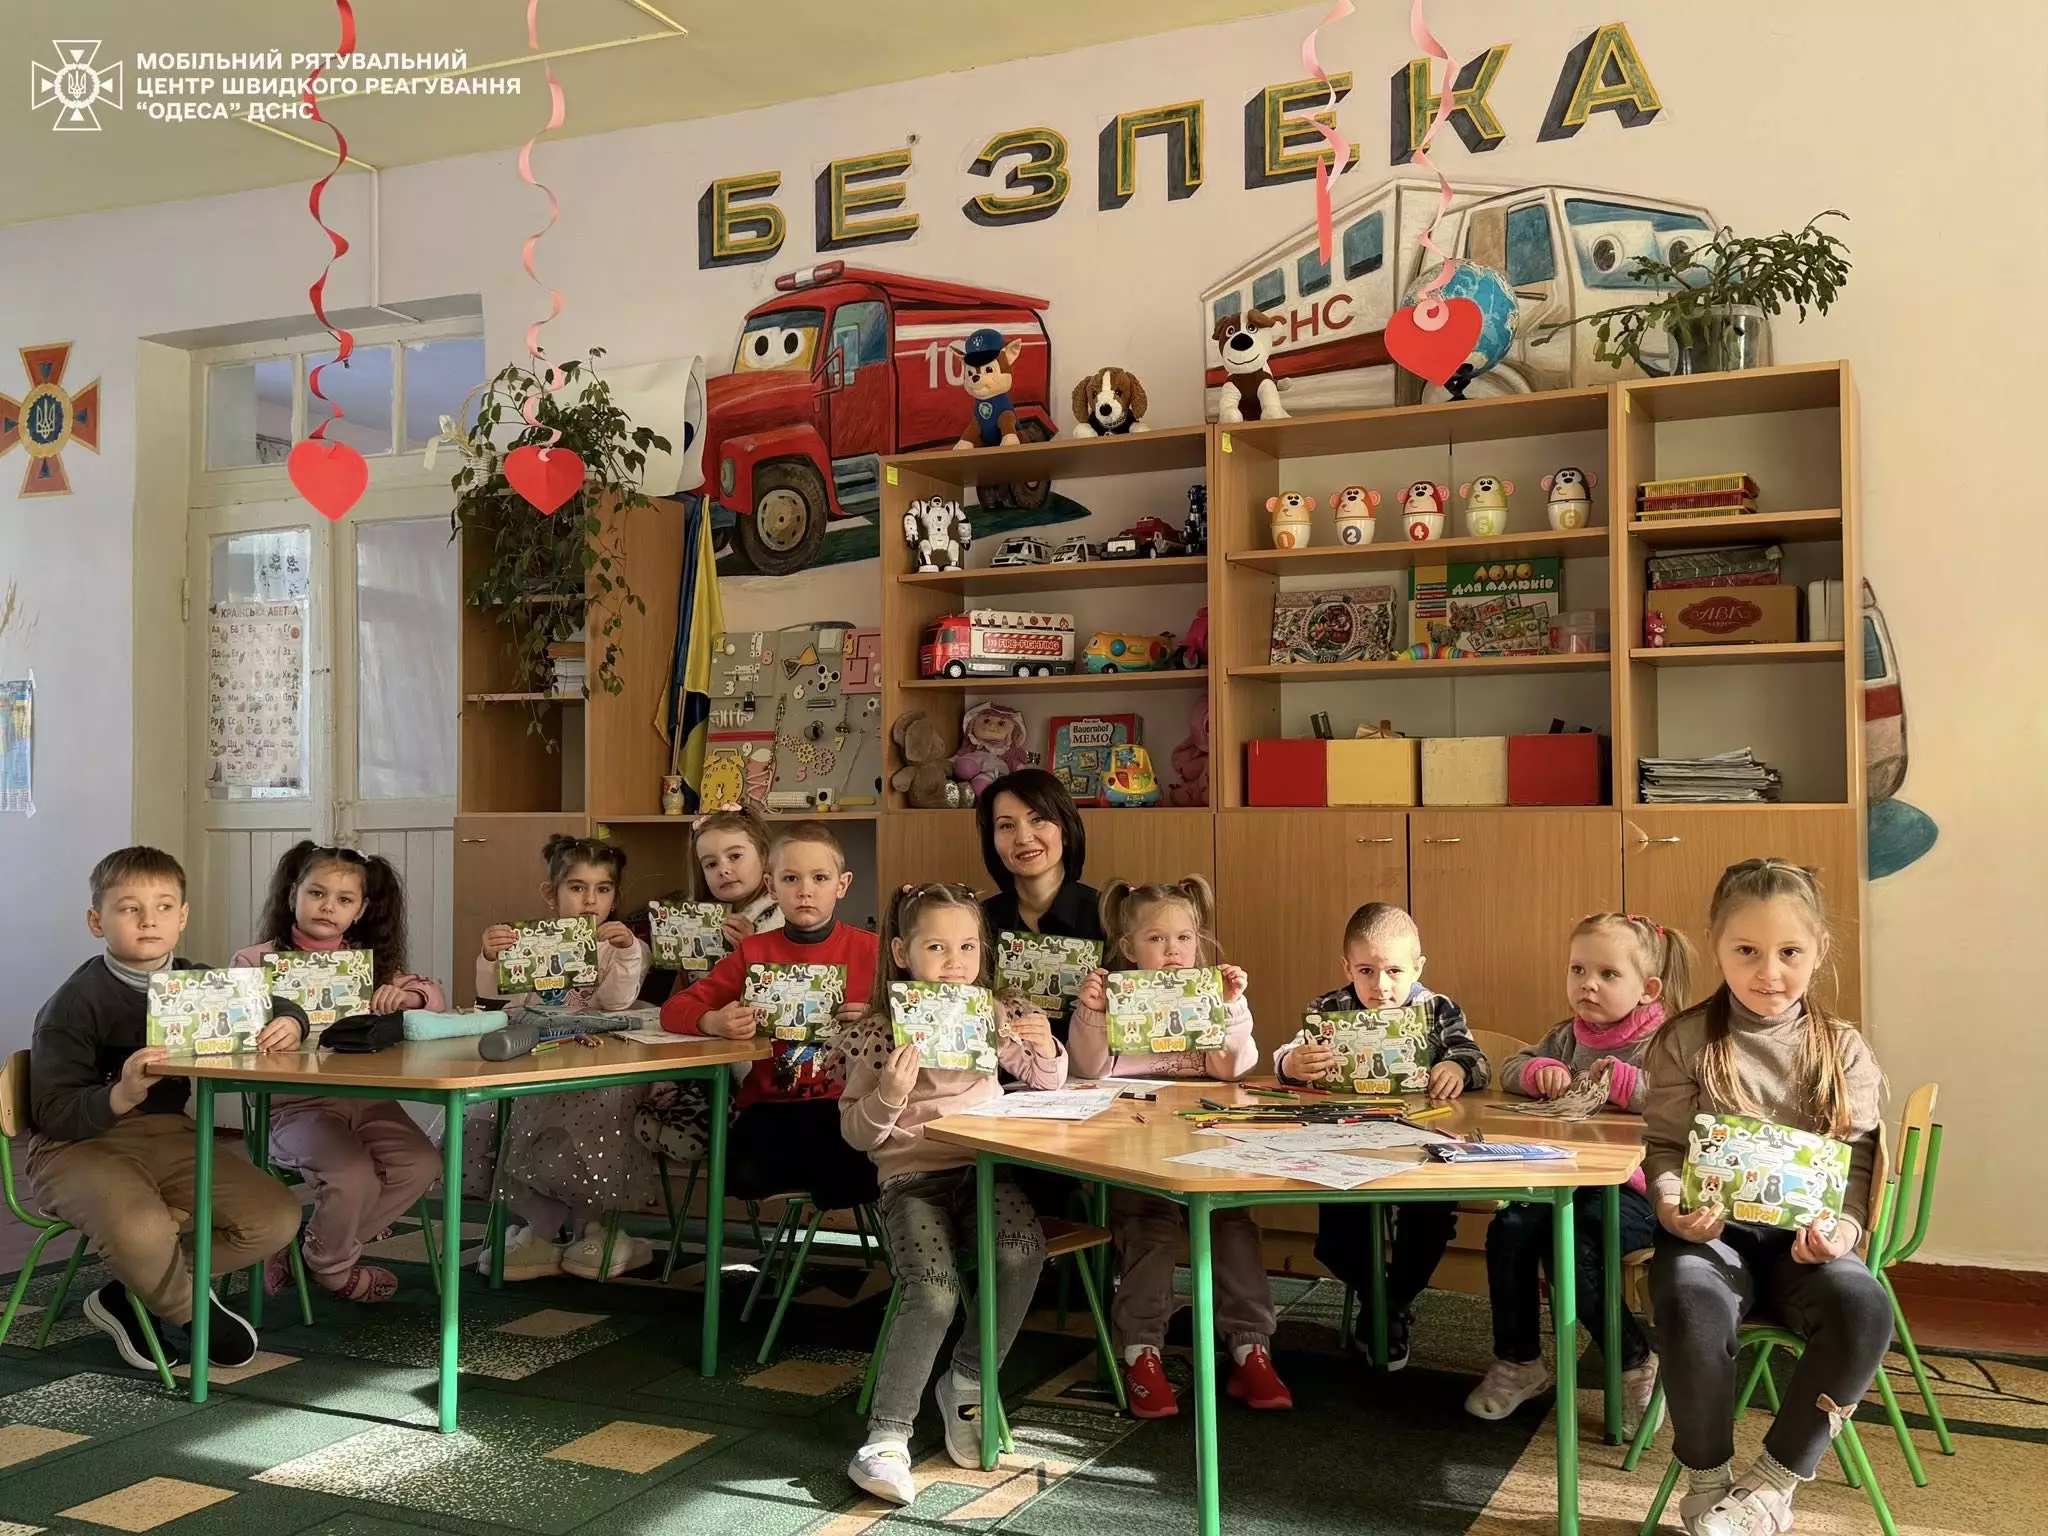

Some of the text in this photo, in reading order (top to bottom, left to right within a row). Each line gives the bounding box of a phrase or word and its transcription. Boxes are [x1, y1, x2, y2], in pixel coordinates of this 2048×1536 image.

[699, 22, 1663, 269] БЕЗПЕКА
[1473, 563, 1533, 581] ЛОТО
[999, 639, 1060, 651] FIRE-FIGHTING
[761, 650, 774, 665] 8
[723, 680, 736, 696] 3
[793, 684, 805, 699] 6
[1073, 725, 1109, 734] Bauernhof
[1072, 734, 1109, 744] MEMO
[742, 741, 753, 757] 9
